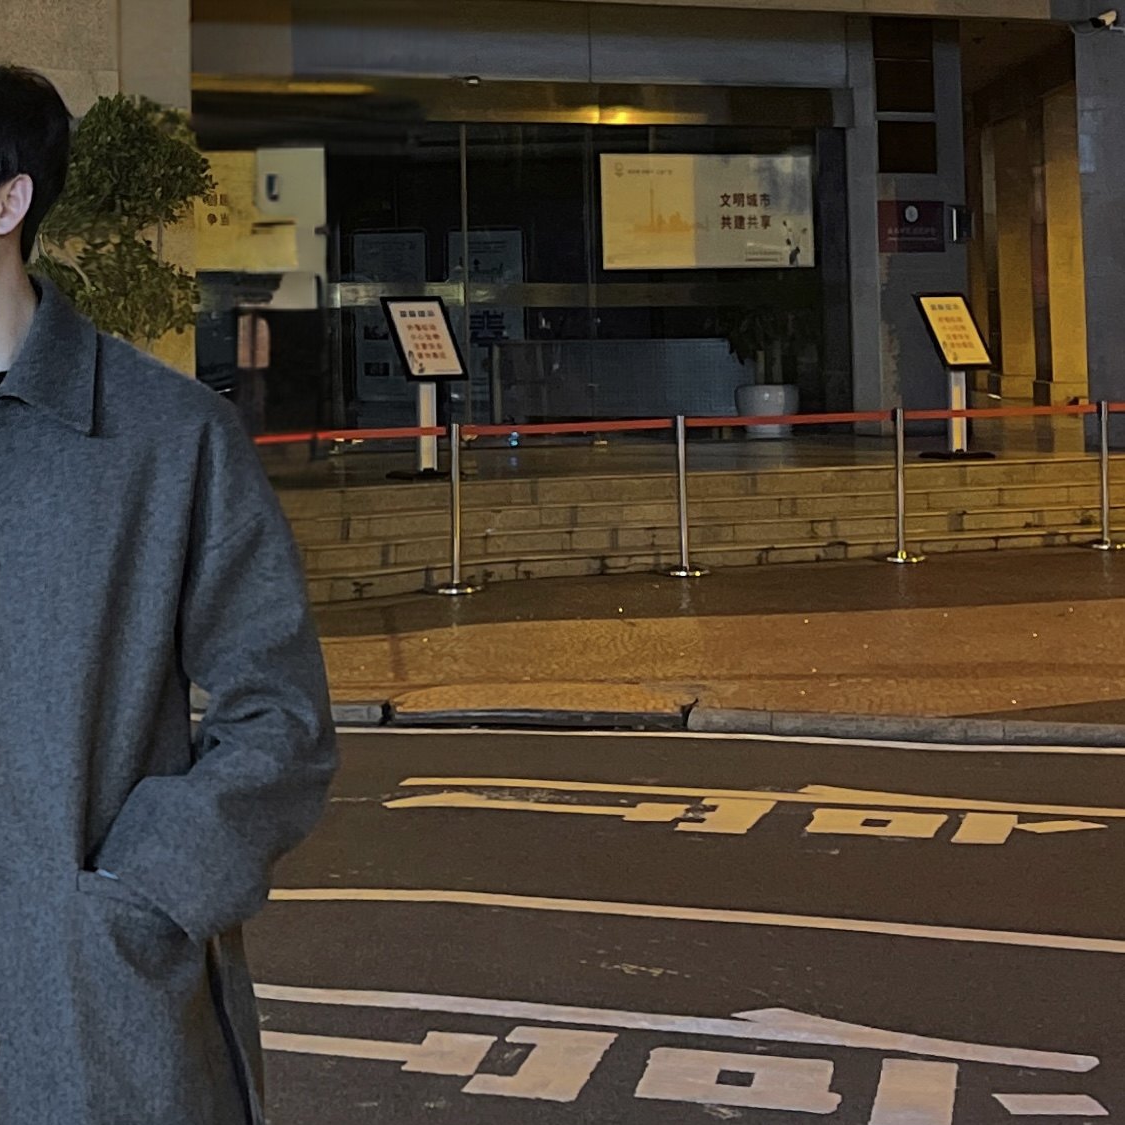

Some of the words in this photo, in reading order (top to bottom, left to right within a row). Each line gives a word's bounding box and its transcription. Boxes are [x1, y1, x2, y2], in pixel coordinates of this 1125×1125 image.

[720, 193, 771, 208] 文明城市
[720, 215, 771, 230] 共建共享
